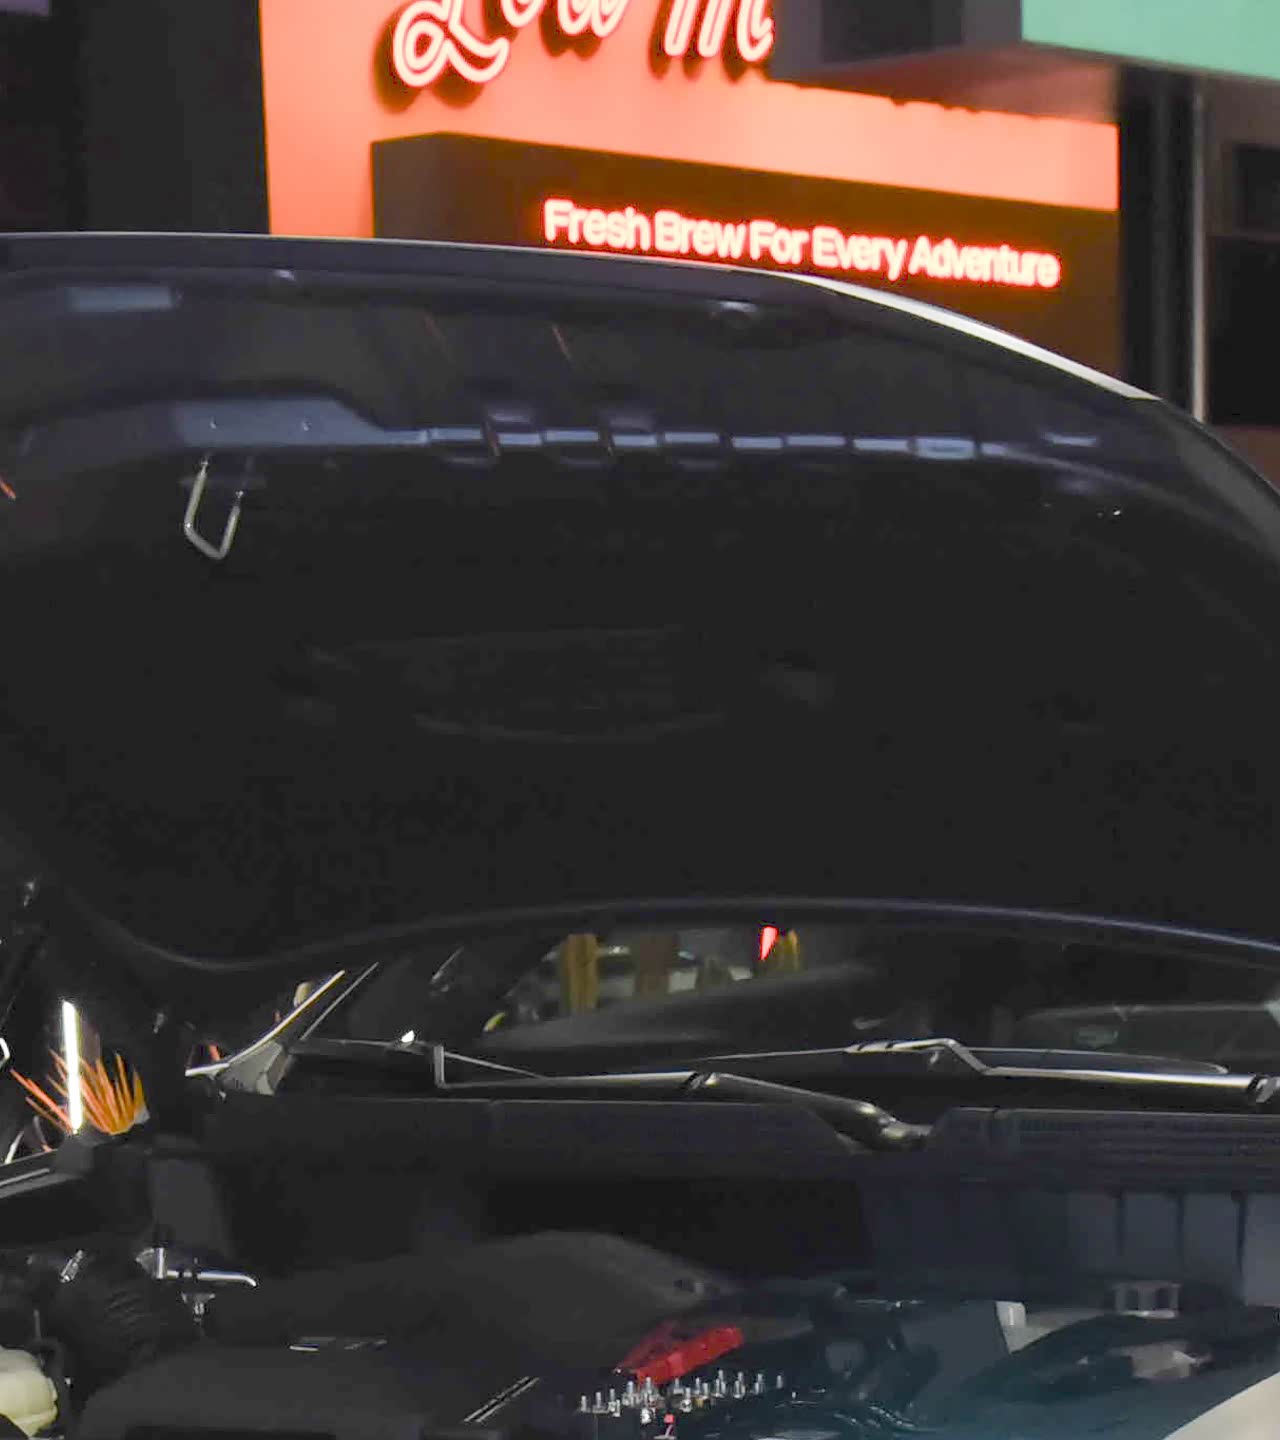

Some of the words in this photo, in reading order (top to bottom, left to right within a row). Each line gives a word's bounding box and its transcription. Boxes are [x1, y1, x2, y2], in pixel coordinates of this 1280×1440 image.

[544, 199, 651, 251] Fresh
[654, 210, 746, 259] Brew
[749, 220, 809, 265] For
[812, 226, 908, 282] Every
[908, 235, 1061, 288] Adventure
